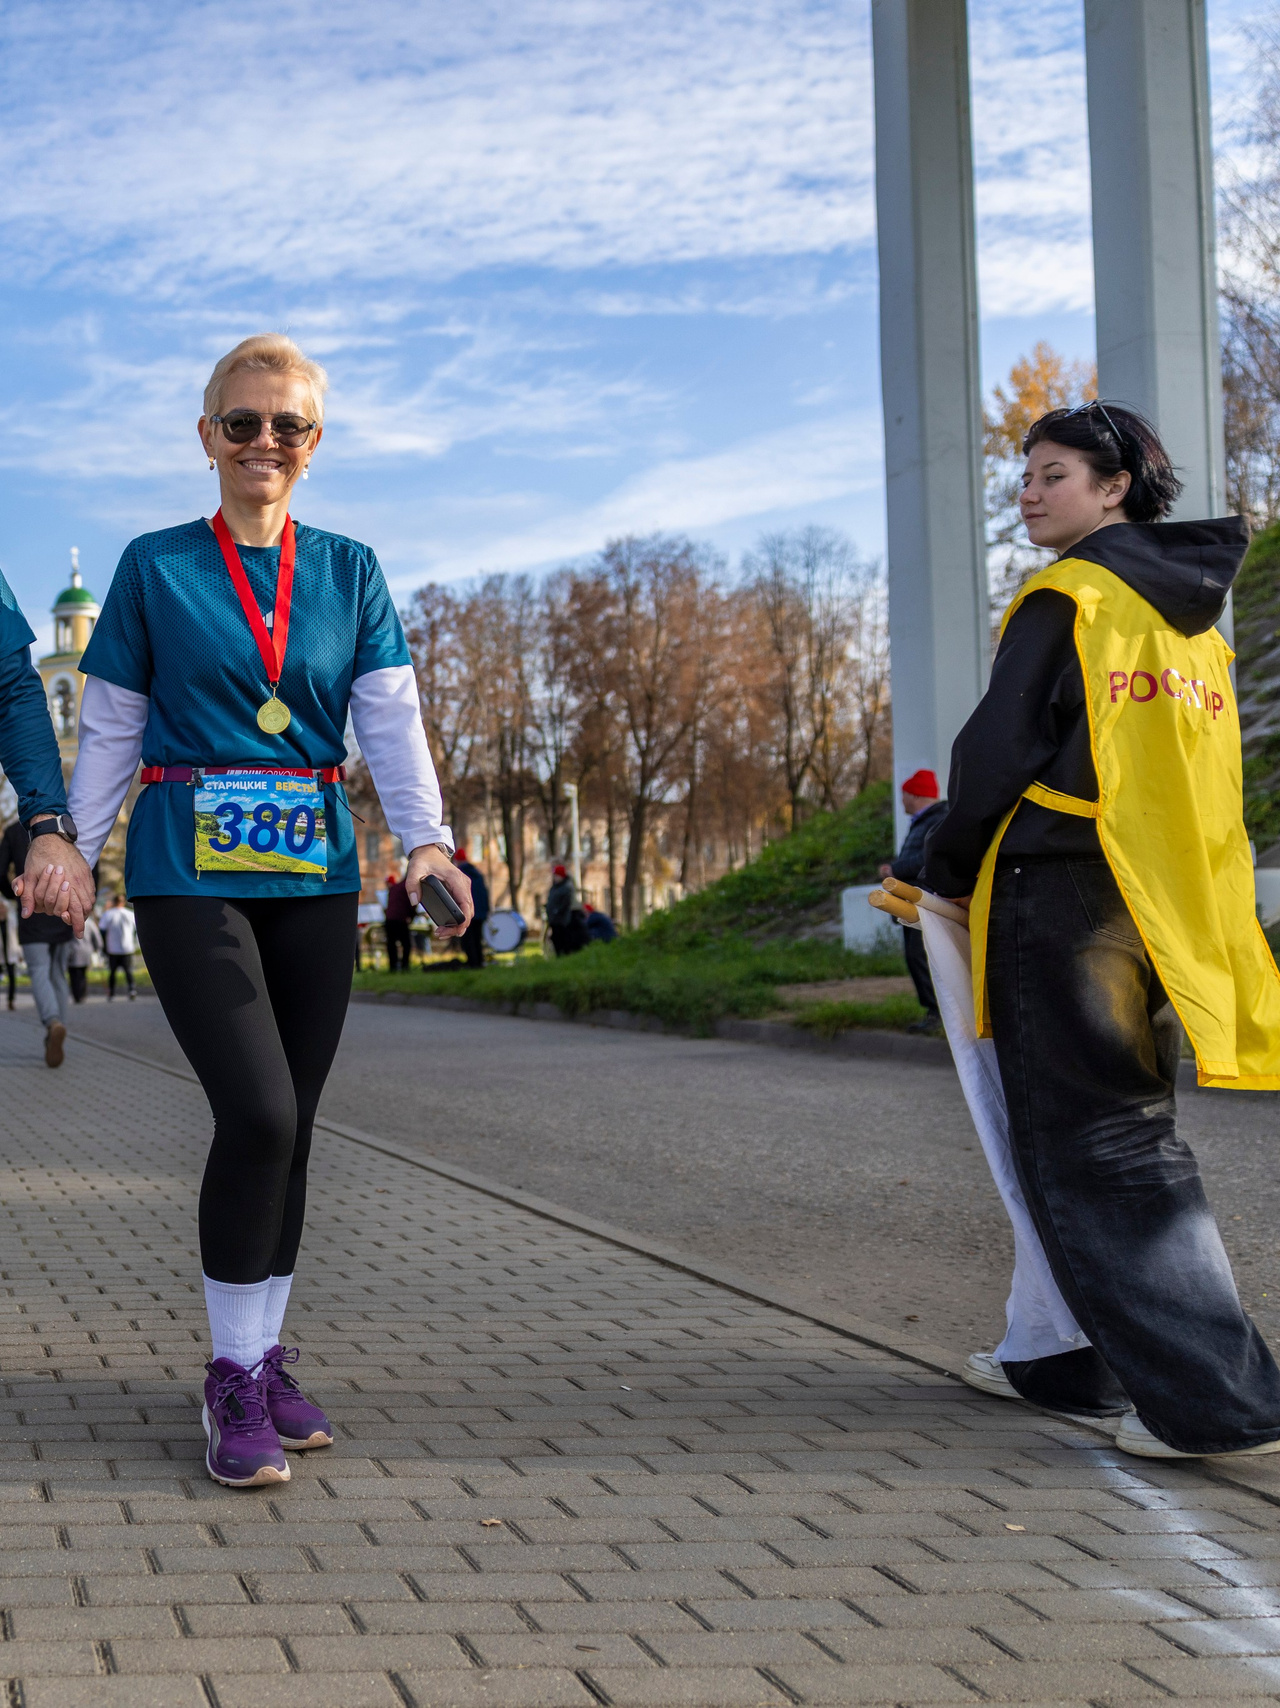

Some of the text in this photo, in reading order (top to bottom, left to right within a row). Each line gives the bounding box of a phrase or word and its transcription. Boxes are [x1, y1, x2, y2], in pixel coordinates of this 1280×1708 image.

[204, 781, 316, 793] СТАРИЦКИЕ ВЕРСТЫ
[208, 802, 316, 854] 380
